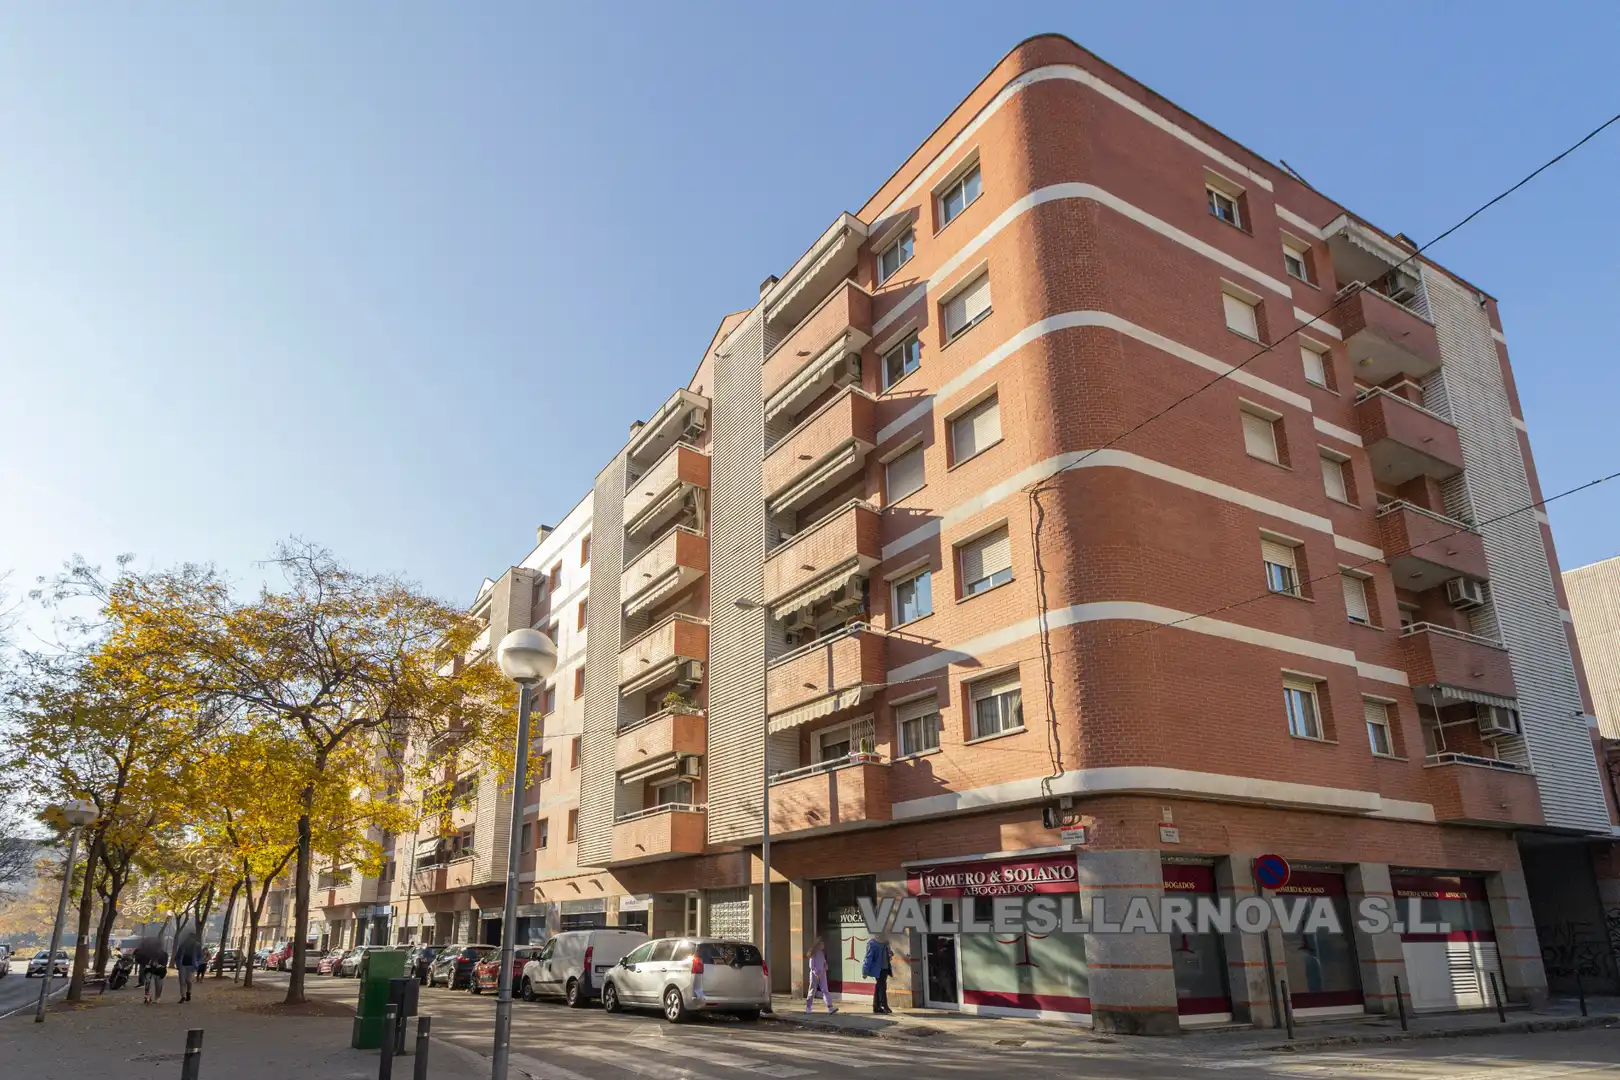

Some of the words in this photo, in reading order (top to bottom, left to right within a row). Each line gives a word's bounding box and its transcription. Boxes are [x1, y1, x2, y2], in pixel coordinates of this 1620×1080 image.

[924, 872, 986, 888] ROMERO
[990, 869, 1002, 883] &
[1003, 865, 1076, 882] SOLANO
[962, 883, 1037, 896] ABOGADOS
[1163, 881, 1196, 890] BOGADOS
